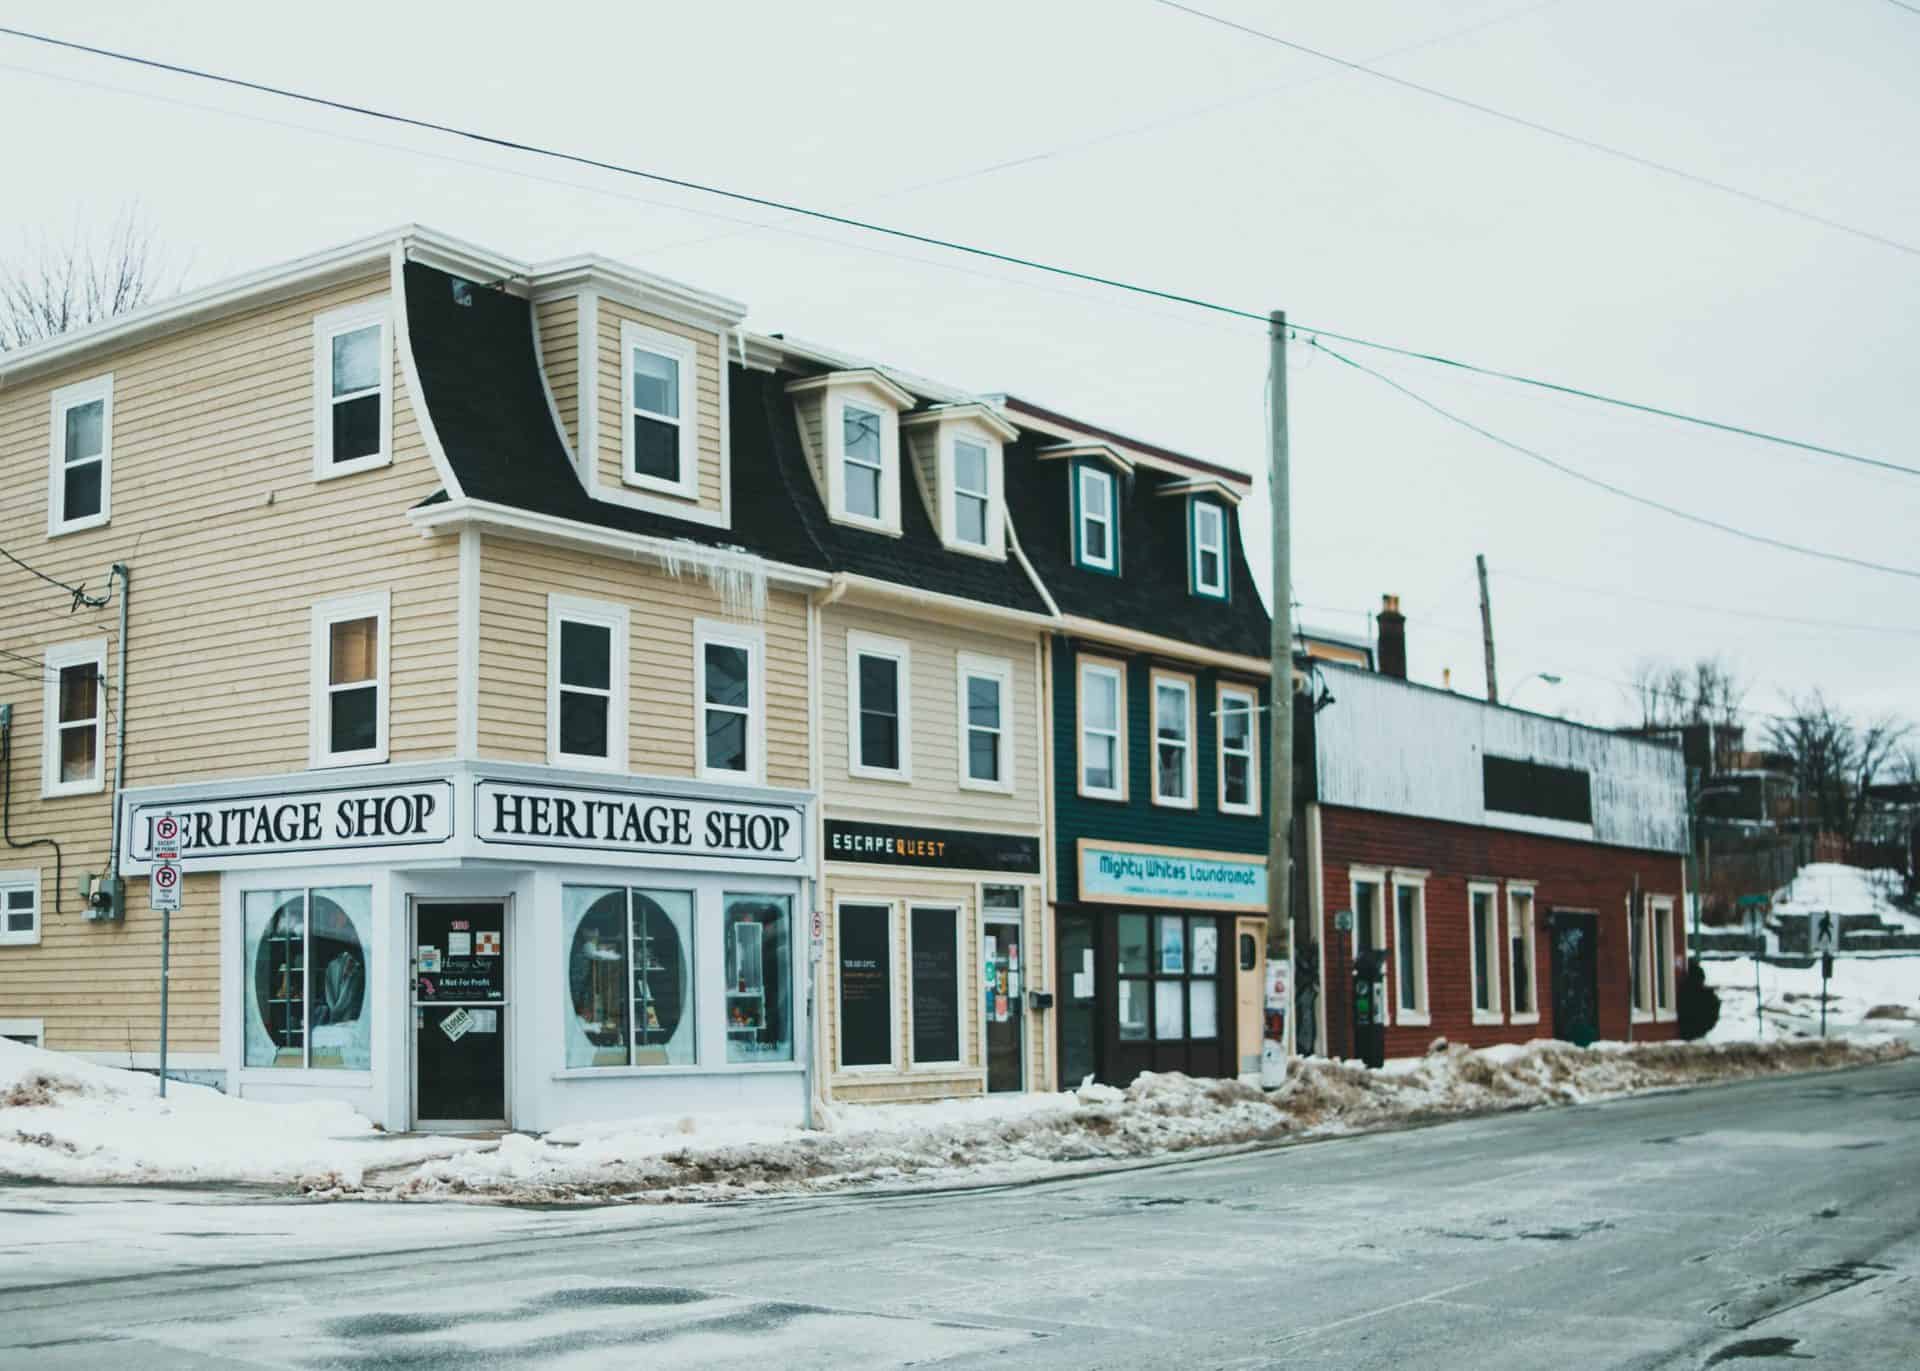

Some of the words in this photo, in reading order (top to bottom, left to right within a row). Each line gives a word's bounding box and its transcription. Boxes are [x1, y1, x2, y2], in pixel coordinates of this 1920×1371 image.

[336, 793, 436, 838] SHOP
[493, 793, 692, 845] HERITAGE
[705, 811, 790, 851] SHOP
[1099, 856, 1142, 880] Mighty
[1146, 861, 1187, 881] Whites
[1189, 864, 1256, 885] Laundromat
